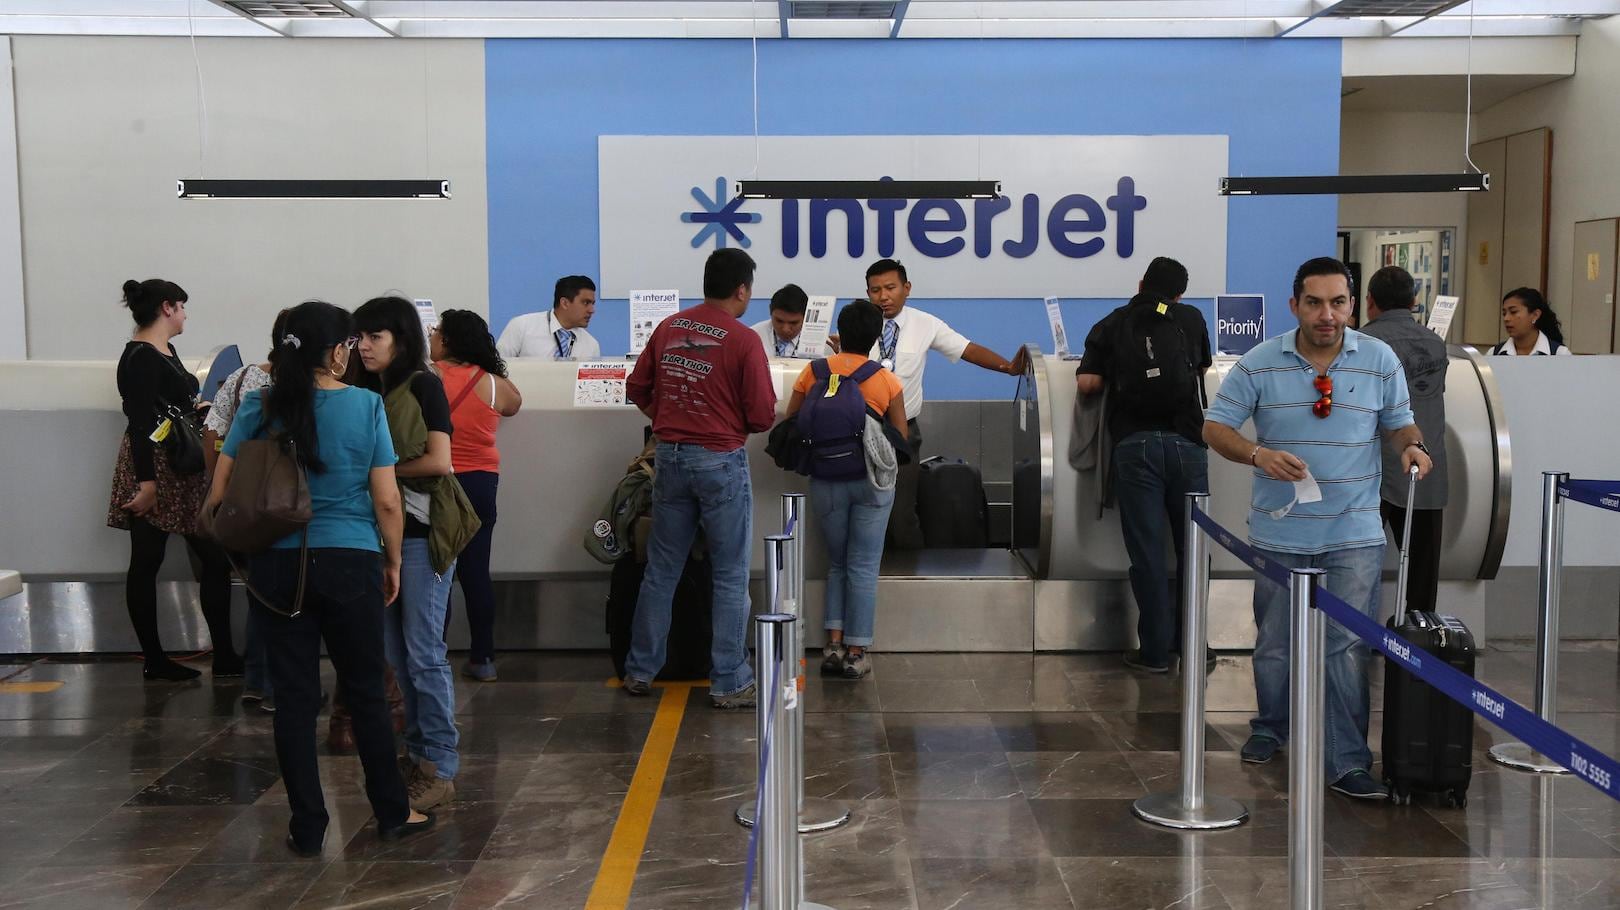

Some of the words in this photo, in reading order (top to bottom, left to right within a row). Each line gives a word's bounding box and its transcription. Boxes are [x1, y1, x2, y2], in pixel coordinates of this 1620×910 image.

[781, 176, 1147, 259] interjet
[642, 293, 676, 302] interjet
[689, 321, 728, 340] FORCE
[1218, 315, 1263, 339] Priority
[1476, 690, 1505, 720] interjet
[1589, 763, 1611, 789] 5555
